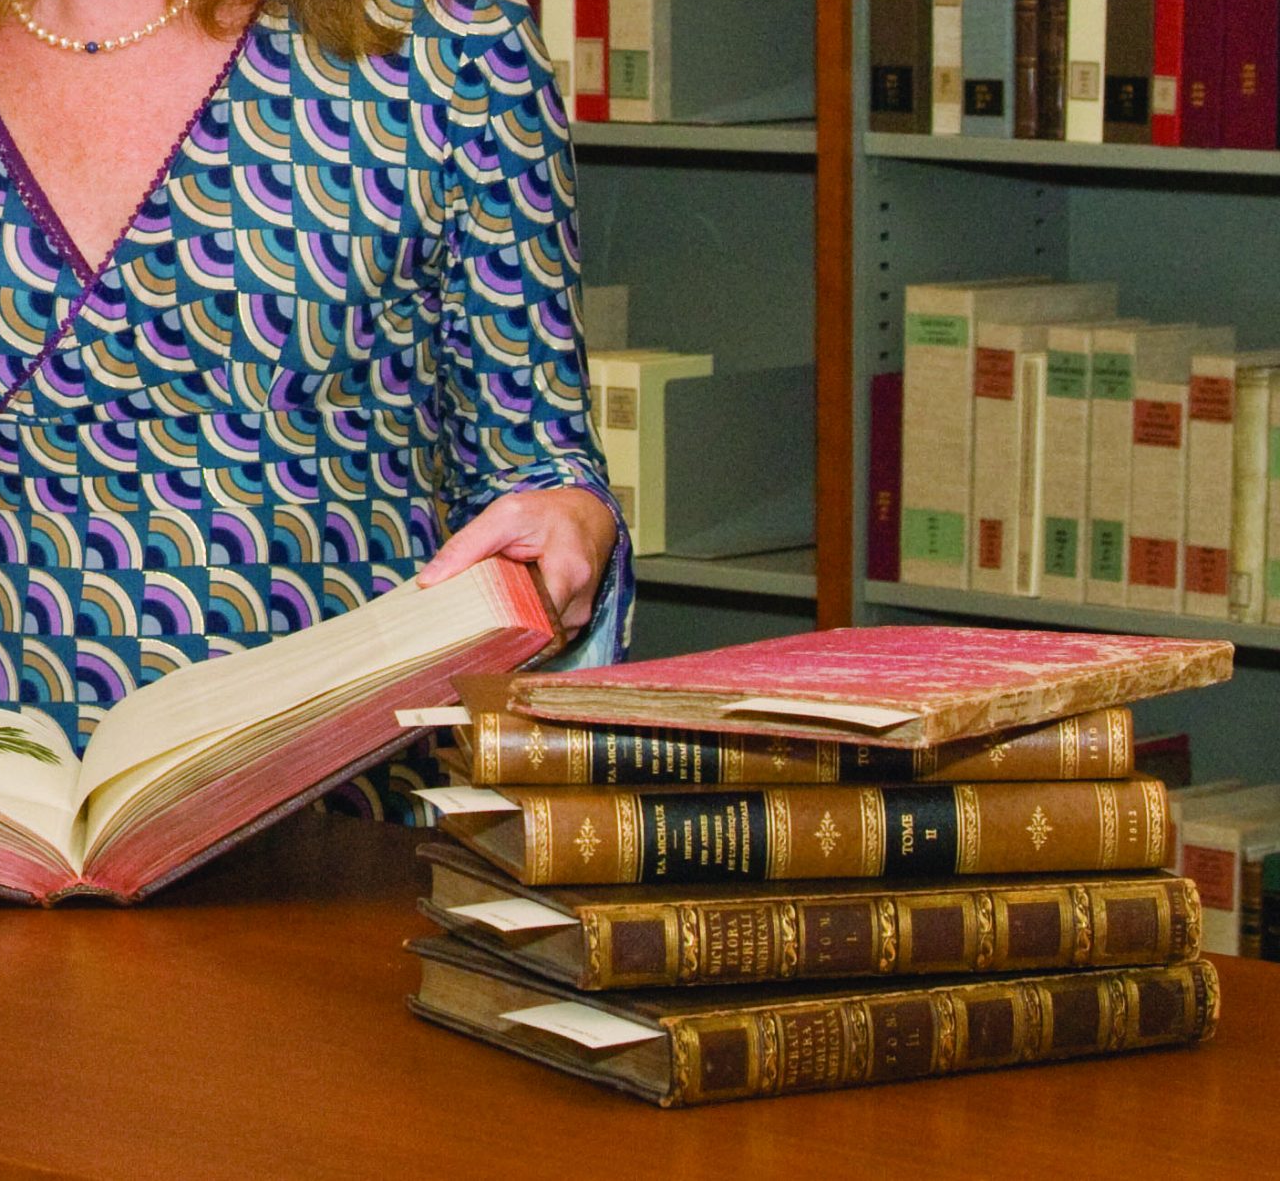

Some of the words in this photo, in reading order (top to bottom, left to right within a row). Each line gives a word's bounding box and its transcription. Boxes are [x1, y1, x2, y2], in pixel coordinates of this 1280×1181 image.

[654, 804, 667, 856] MICHAUX
[684, 820, 692, 860] HISTOIRE
[714, 815, 723, 864] FORESTIERS
[901, 814, 914, 855] TOME
[925, 829, 937, 840] II
[709, 912, 723, 974] MICHAUX
[726, 918, 739, 965] FLORA
[741, 914, 754, 973] BOREALI
[785, 1020, 799, 1085] MICHAUX
[801, 1026, 813, 1073] FLORA
